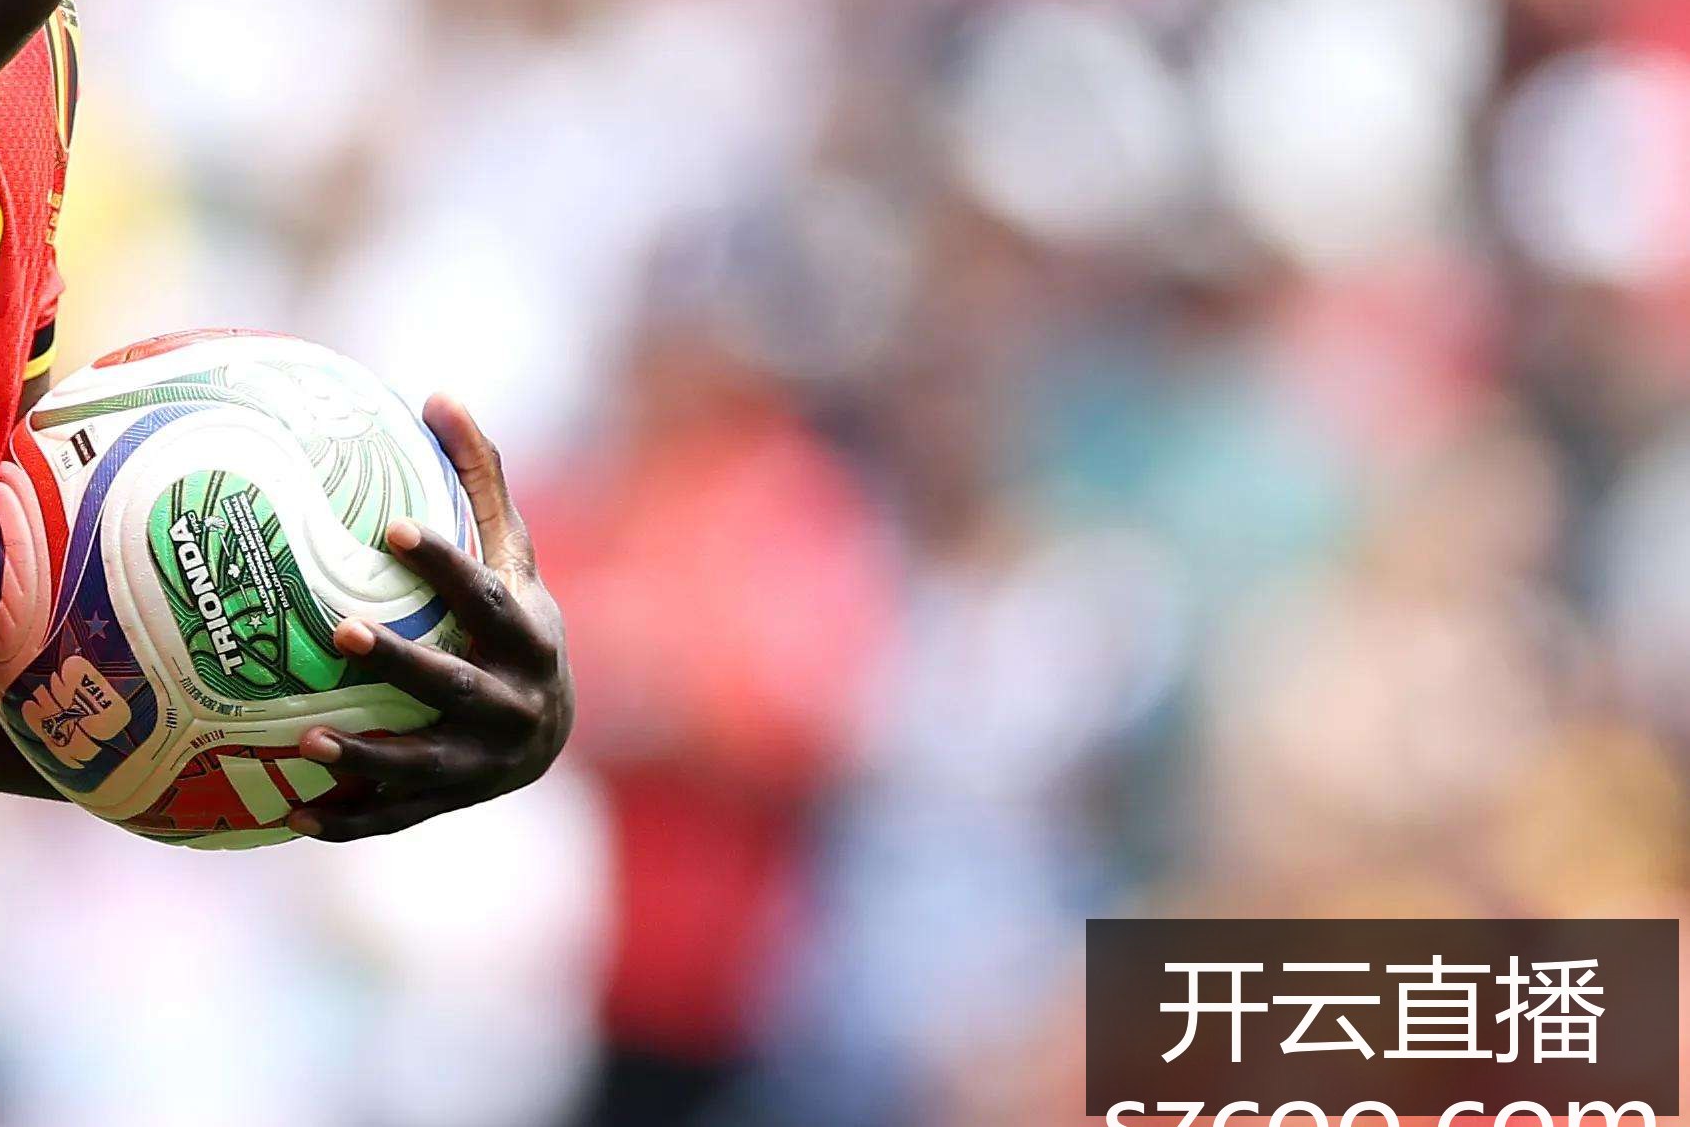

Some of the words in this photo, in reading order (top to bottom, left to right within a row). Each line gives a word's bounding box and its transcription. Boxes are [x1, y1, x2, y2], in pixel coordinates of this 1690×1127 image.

[187, 511, 202, 534] PRO
[168, 514, 244, 675] TRIONDA
[81, 674, 112, 710] FIFA
